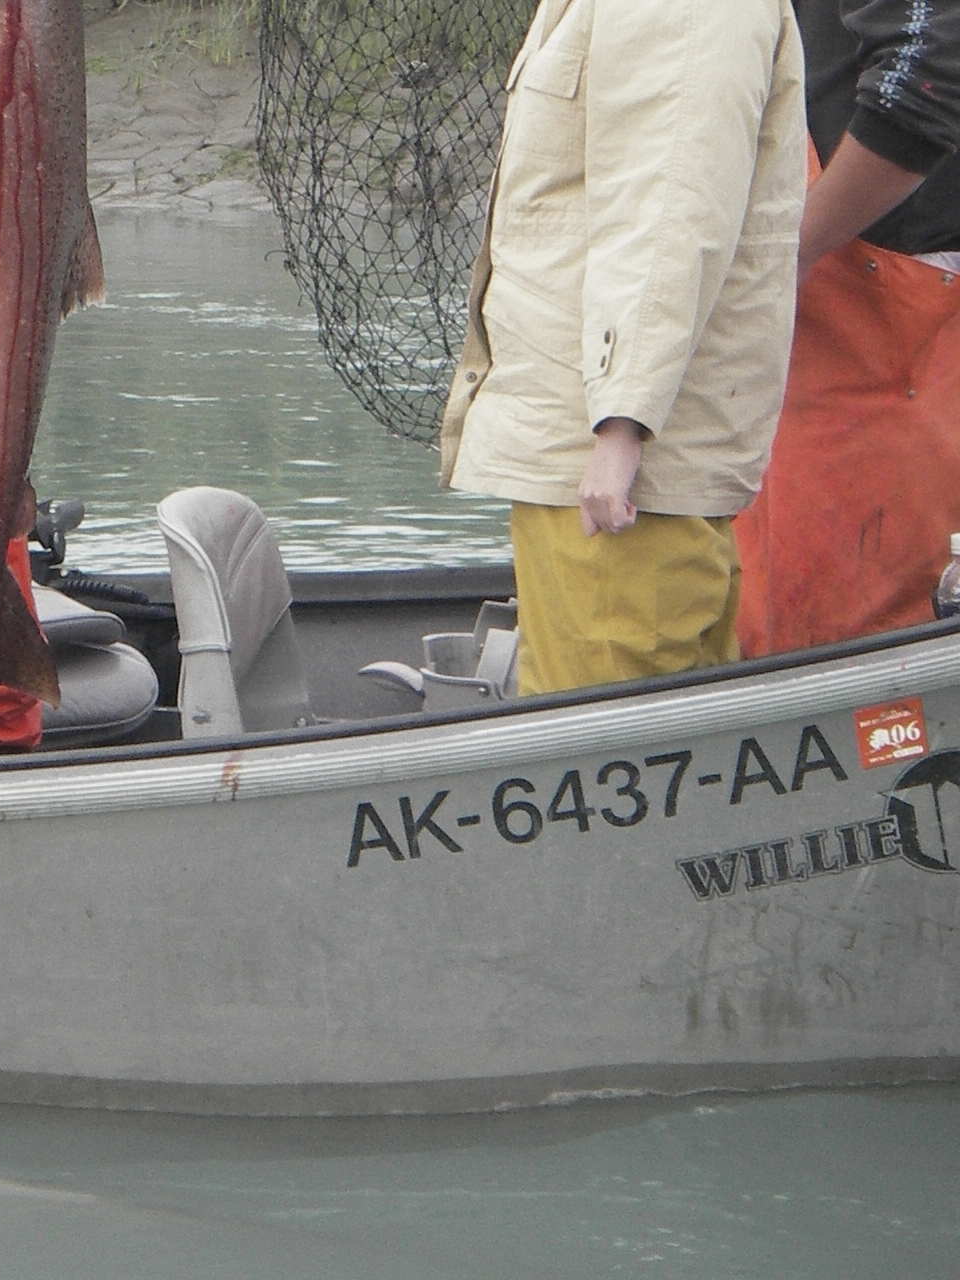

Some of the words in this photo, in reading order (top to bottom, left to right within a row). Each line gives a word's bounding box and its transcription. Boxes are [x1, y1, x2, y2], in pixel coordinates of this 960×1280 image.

[891, 720, 920, 744] 06
[347, 724, 848, 868] AK-6437-AA
[676, 815, 901, 901] WILLIE
